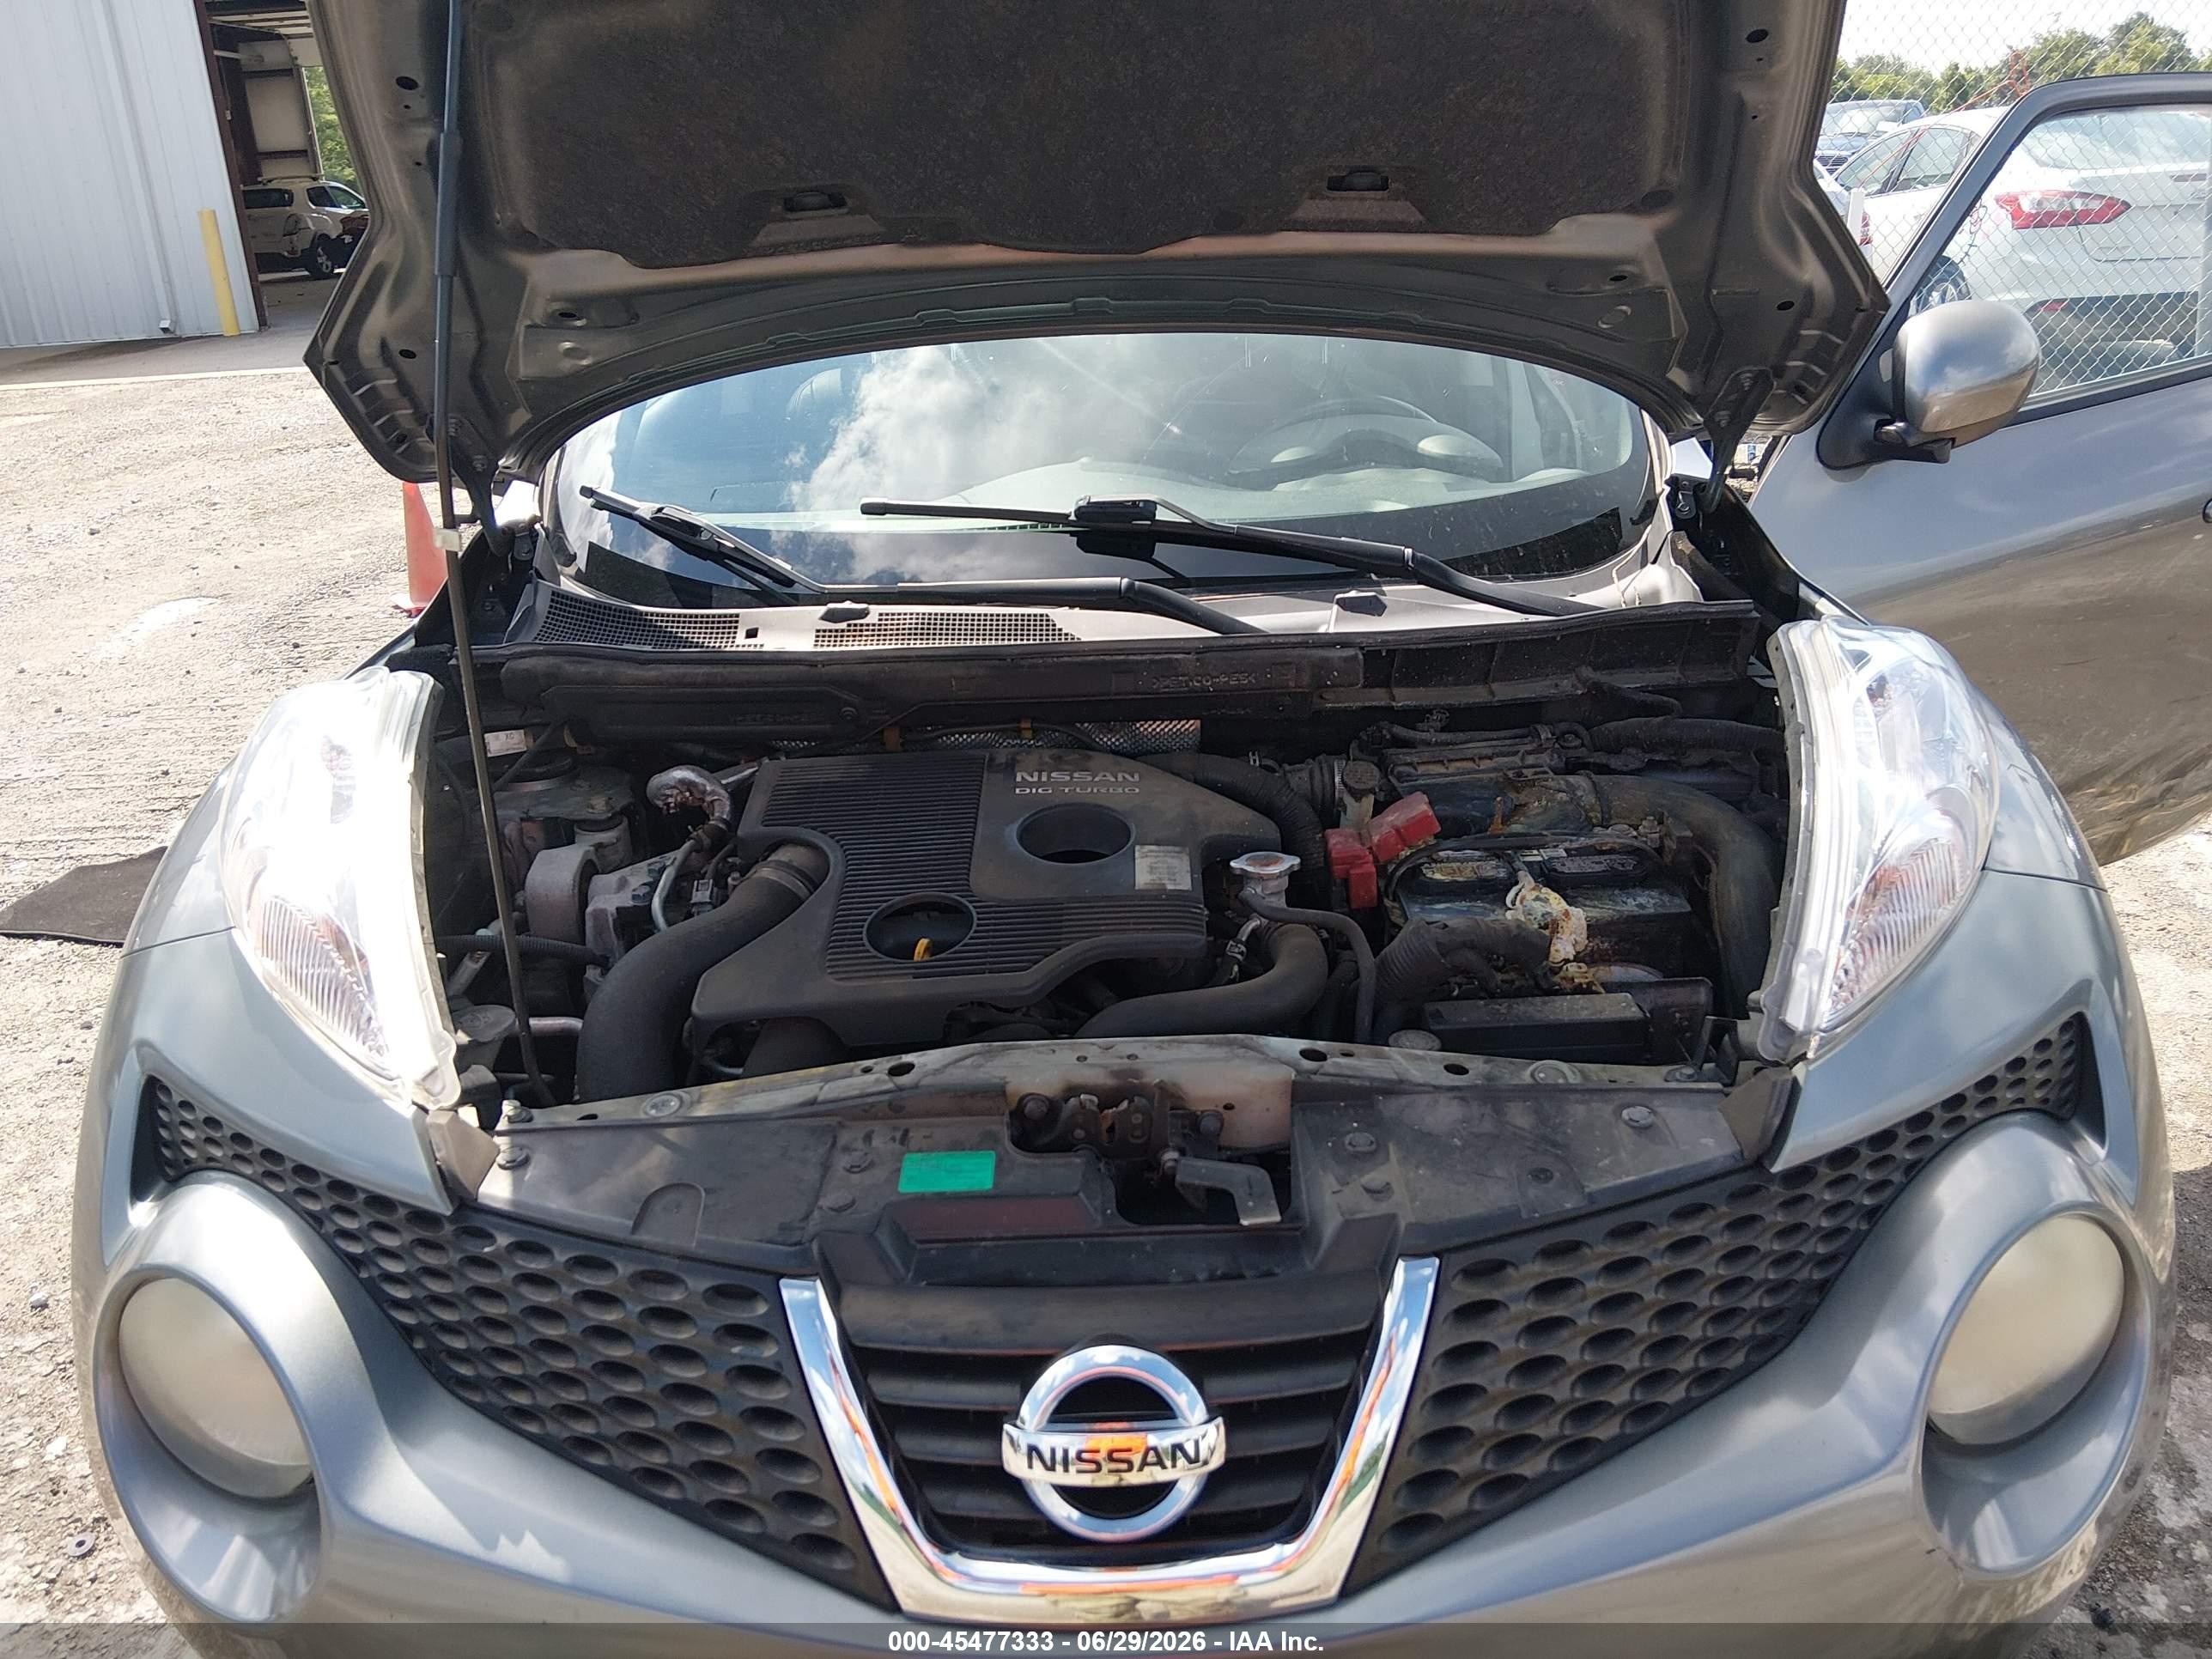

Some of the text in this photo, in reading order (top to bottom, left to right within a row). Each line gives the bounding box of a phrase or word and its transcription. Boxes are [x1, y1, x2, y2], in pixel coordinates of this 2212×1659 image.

[1015, 771, 1140, 782] NISSAN
[1057, 786, 1140, 794] TURBO
[1026, 1437, 1202, 1474] NISSAN
